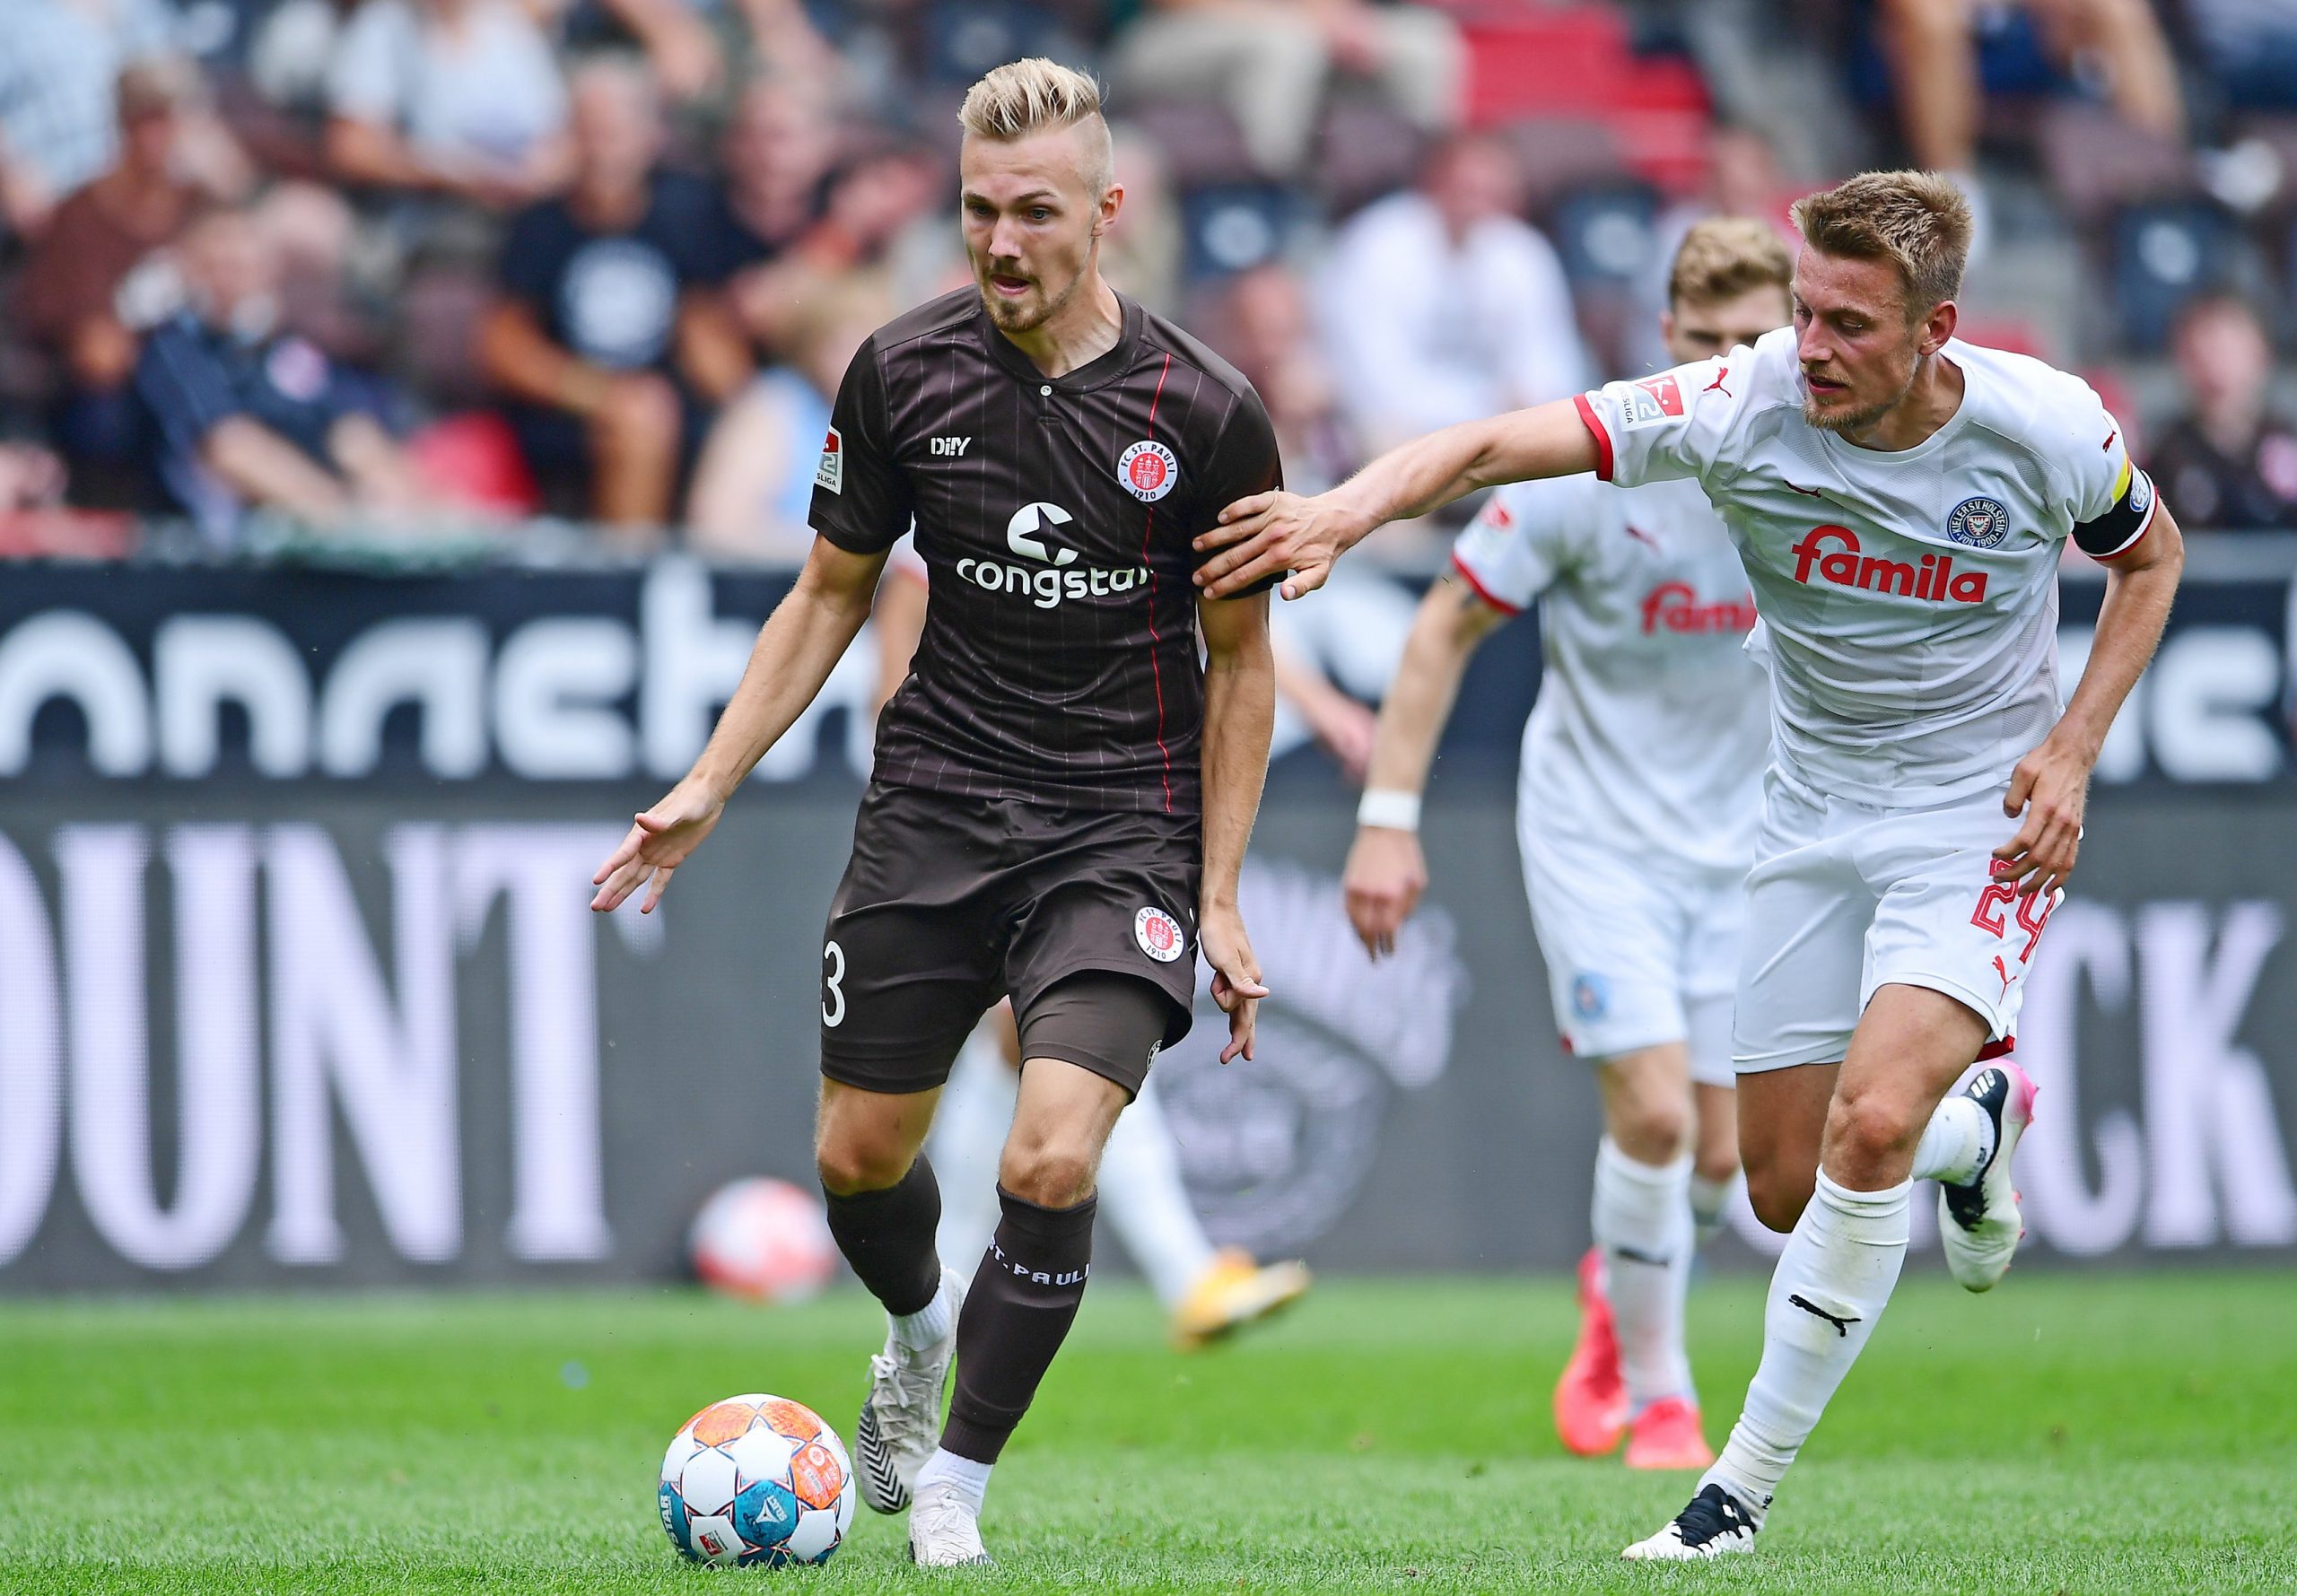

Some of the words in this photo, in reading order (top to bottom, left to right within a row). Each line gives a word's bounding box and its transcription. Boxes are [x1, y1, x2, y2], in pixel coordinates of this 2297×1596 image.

[1121, 455, 1131, 467] FC
[1131, 444, 1147, 455] ST.
[1151, 444, 1175, 473] PAULI
[817, 472, 837, 487] SLIGA
[1133, 489, 1157, 500] 1910
[1951, 505, 1970, 534] KIELER
[1981, 501, 2005, 533] HOLSTEIN
[1957, 533, 1976, 546] VON
[1976, 534, 1998, 547] 1900
[1791, 524, 1988, 603] famila
[1970, 858, 2056, 964] 24
[1138, 911, 1147, 923] FC
[1161, 912, 1182, 943] PAULI
[1146, 945, 1166, 960] 1910
[822, 940, 845, 1027] 3
[1013, 1262, 1090, 1286] PAULI
